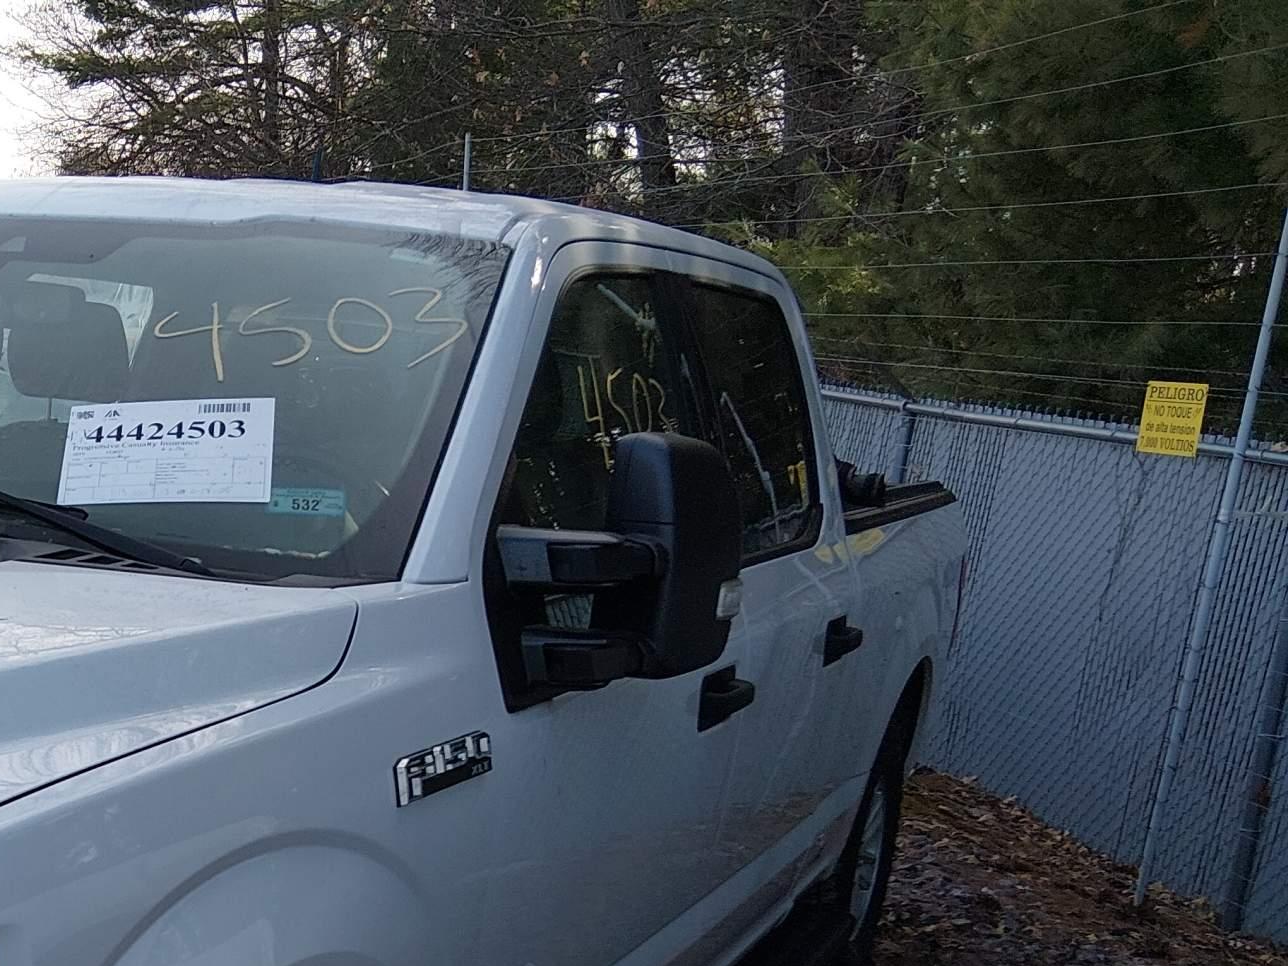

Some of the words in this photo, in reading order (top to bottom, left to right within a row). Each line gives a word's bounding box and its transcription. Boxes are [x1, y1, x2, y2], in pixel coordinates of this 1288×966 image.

[154, 287, 468, 382] 4503
[1149, 386, 1205, 401] PELIGRO
[1154, 404, 1165, 417] NO
[85, 419, 246, 443] 44424503
[1160, 437, 1194, 452] VOLTIOS
[291, 498, 321, 511] 532
